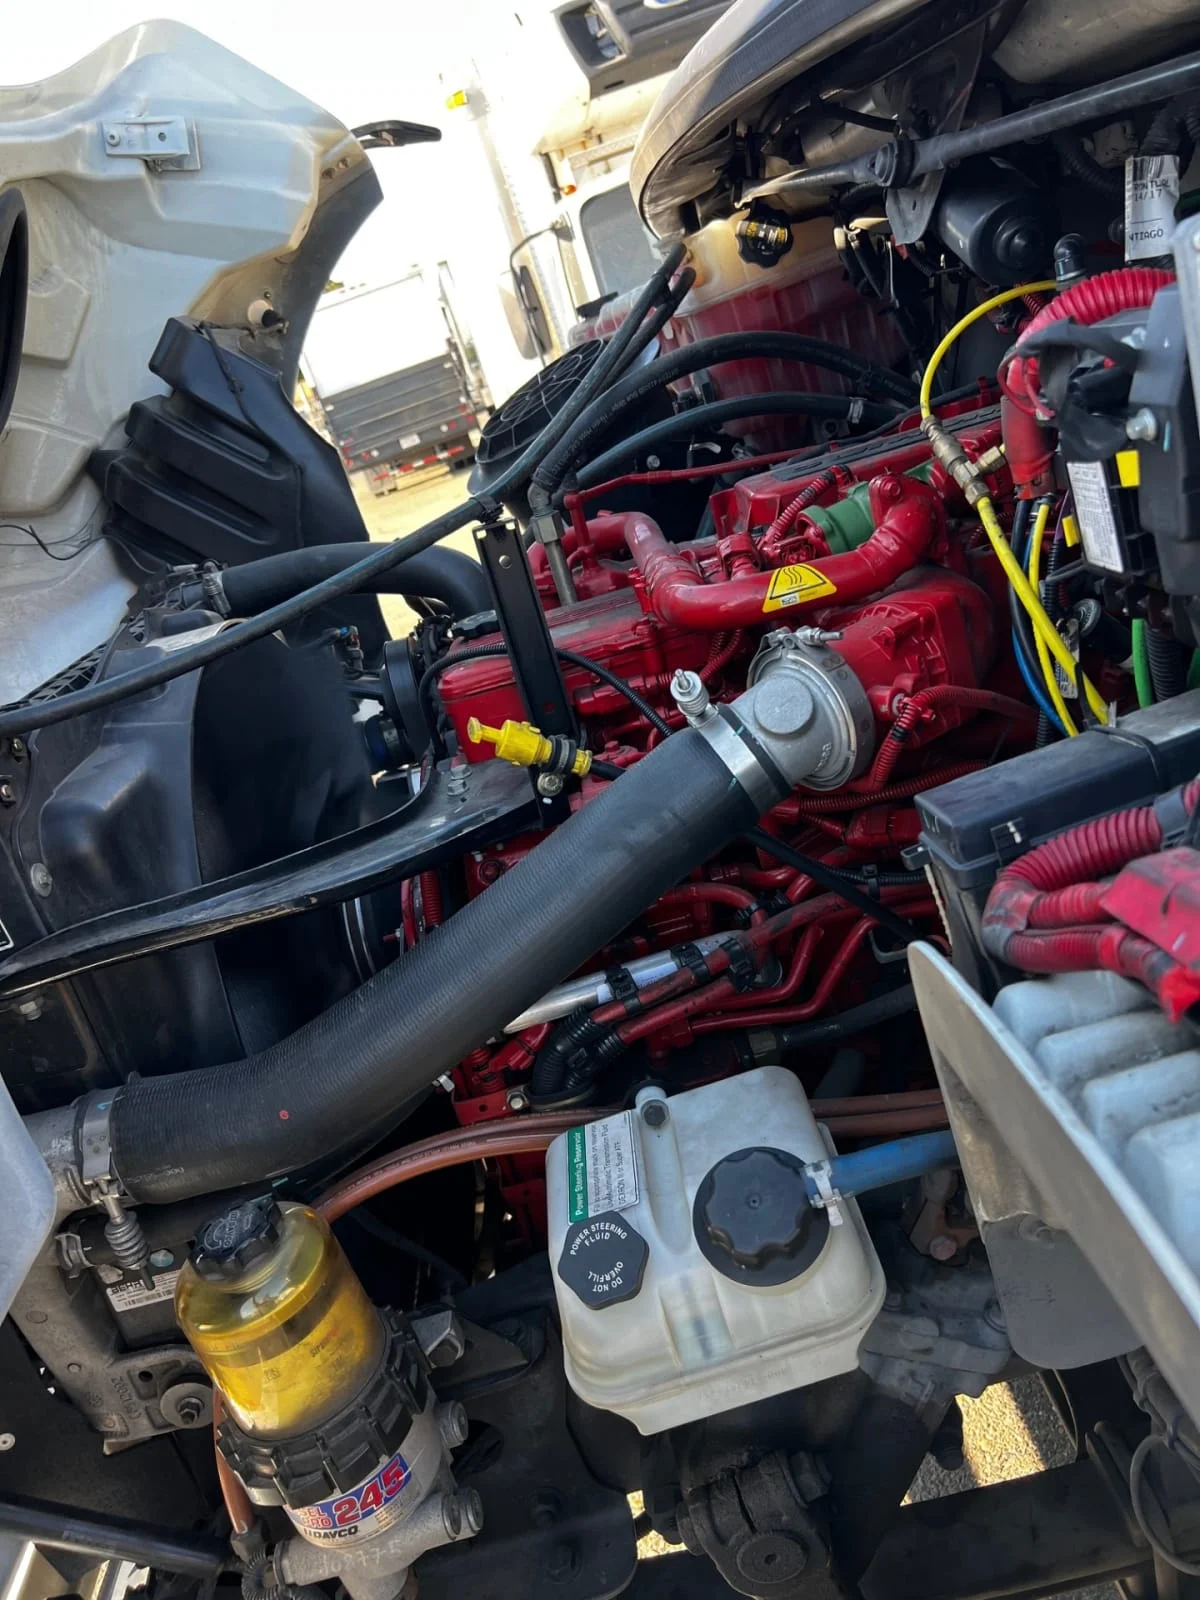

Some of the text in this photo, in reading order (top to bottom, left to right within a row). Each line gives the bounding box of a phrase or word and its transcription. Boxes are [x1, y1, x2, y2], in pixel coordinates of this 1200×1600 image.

[574, 1132, 584, 1216] Power Steering Reservoir
[570, 1222, 628, 1255] POWER STEERING
[584, 1232, 610, 1247] FLUID
[588, 1261, 624, 1283] OVERFILL
[592, 1276, 623, 1292] DO NOT
[332, 1457, 406, 1527] 245
